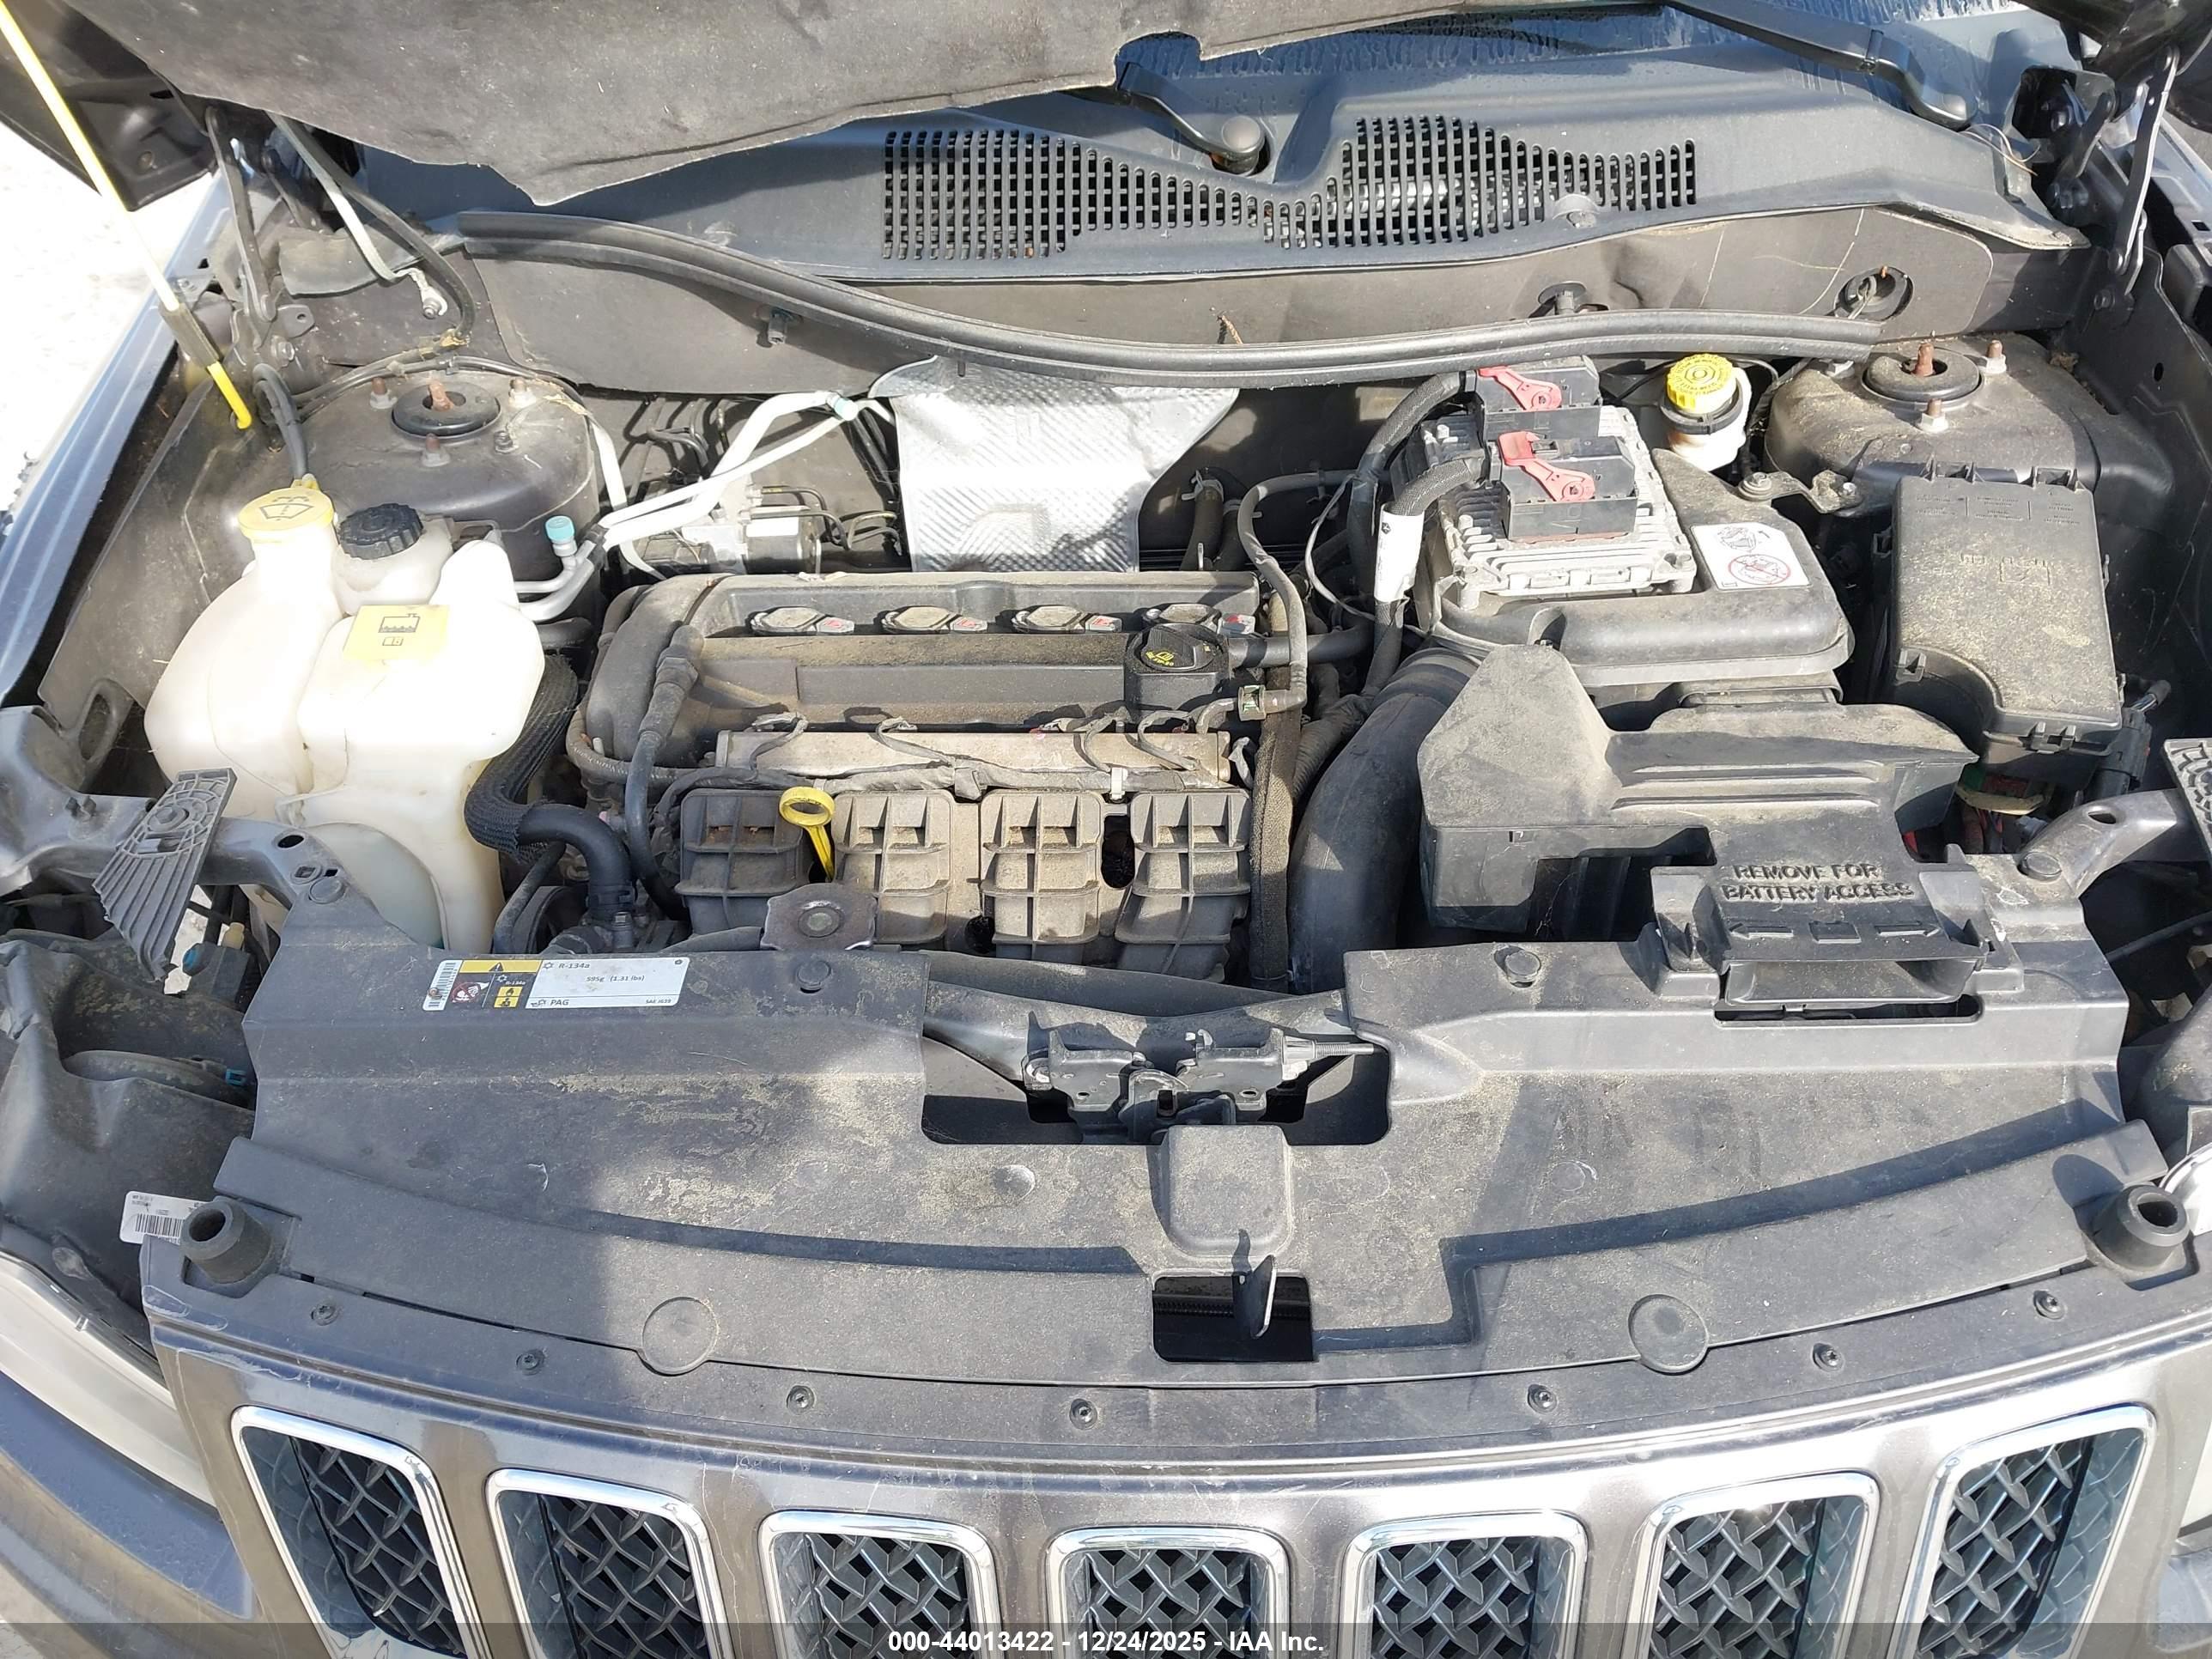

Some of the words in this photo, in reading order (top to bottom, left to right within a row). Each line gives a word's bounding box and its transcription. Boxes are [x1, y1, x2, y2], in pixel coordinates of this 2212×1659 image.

[1735, 864, 1828, 880] REMOVE
[1832, 864, 1881, 879] FOR
[1721, 884, 1817, 901] BATTERY
[1824, 882, 1915, 900] ACCESS
